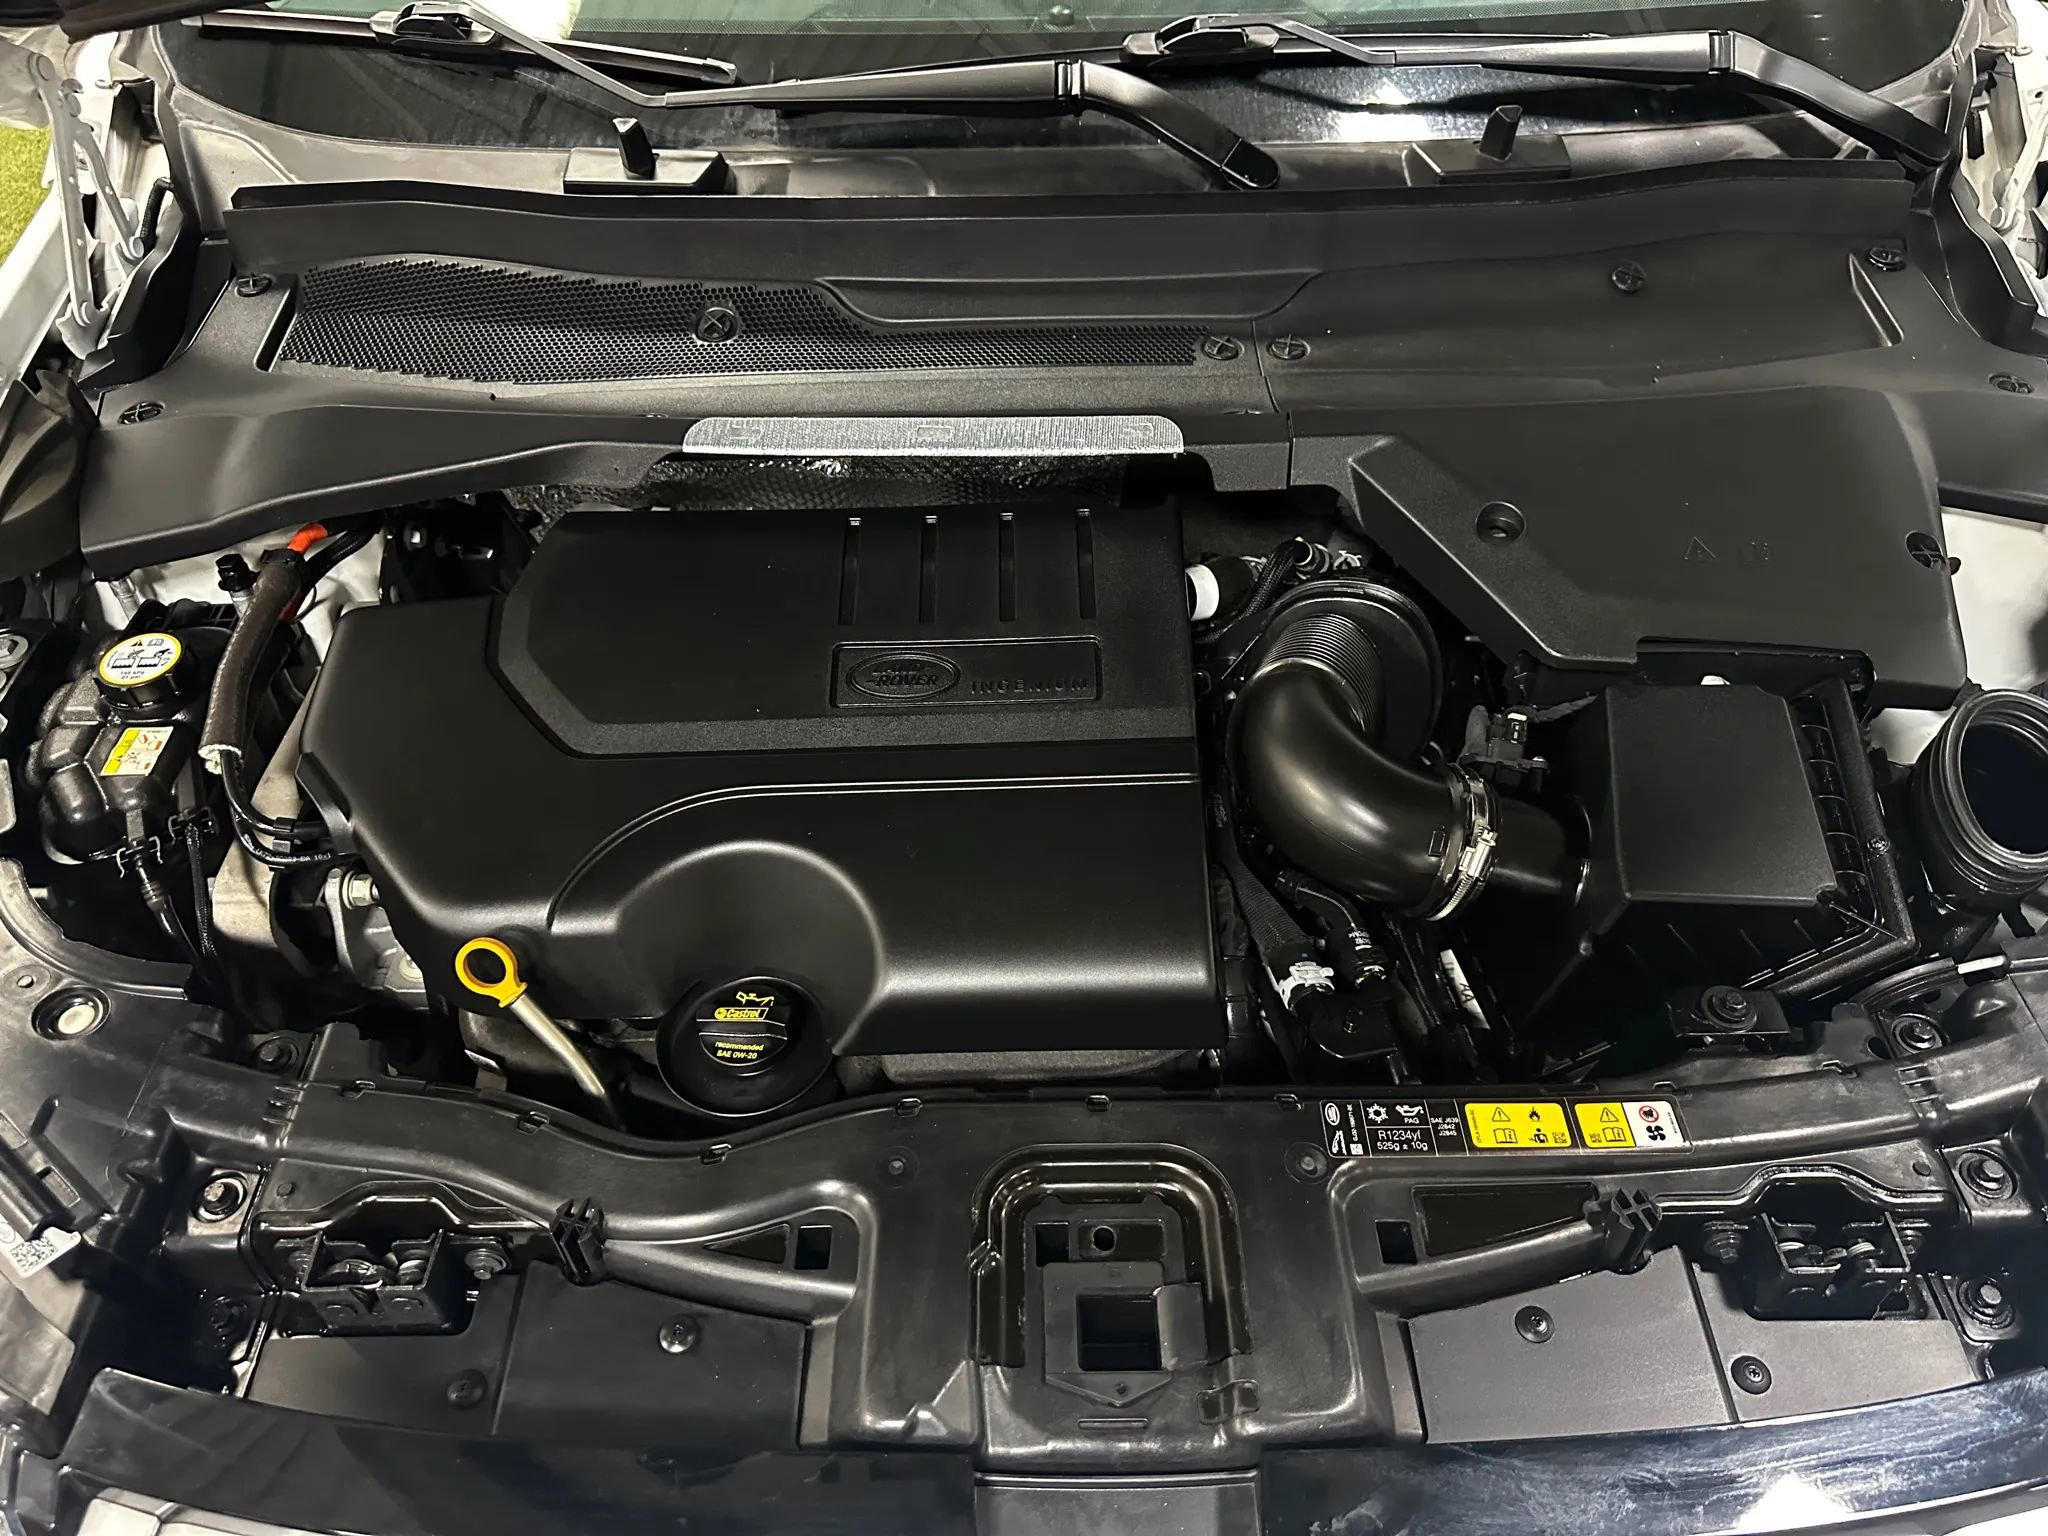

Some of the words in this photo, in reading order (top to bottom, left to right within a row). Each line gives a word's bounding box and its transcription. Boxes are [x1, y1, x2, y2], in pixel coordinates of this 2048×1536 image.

[876, 674, 938, 686] ROVER
[970, 677, 1088, 694] INGENIUM
[726, 1008, 761, 1019] Castrol
[715, 1041, 764, 1051] recommended
[716, 1050, 731, 1058] SAE
[732, 1051, 757, 1059] 0W-20
[1378, 1129, 1421, 1141] R1234yf
[1376, 1142, 1400, 1151] 525g
[1411, 1141, 1428, 1151] 10g
